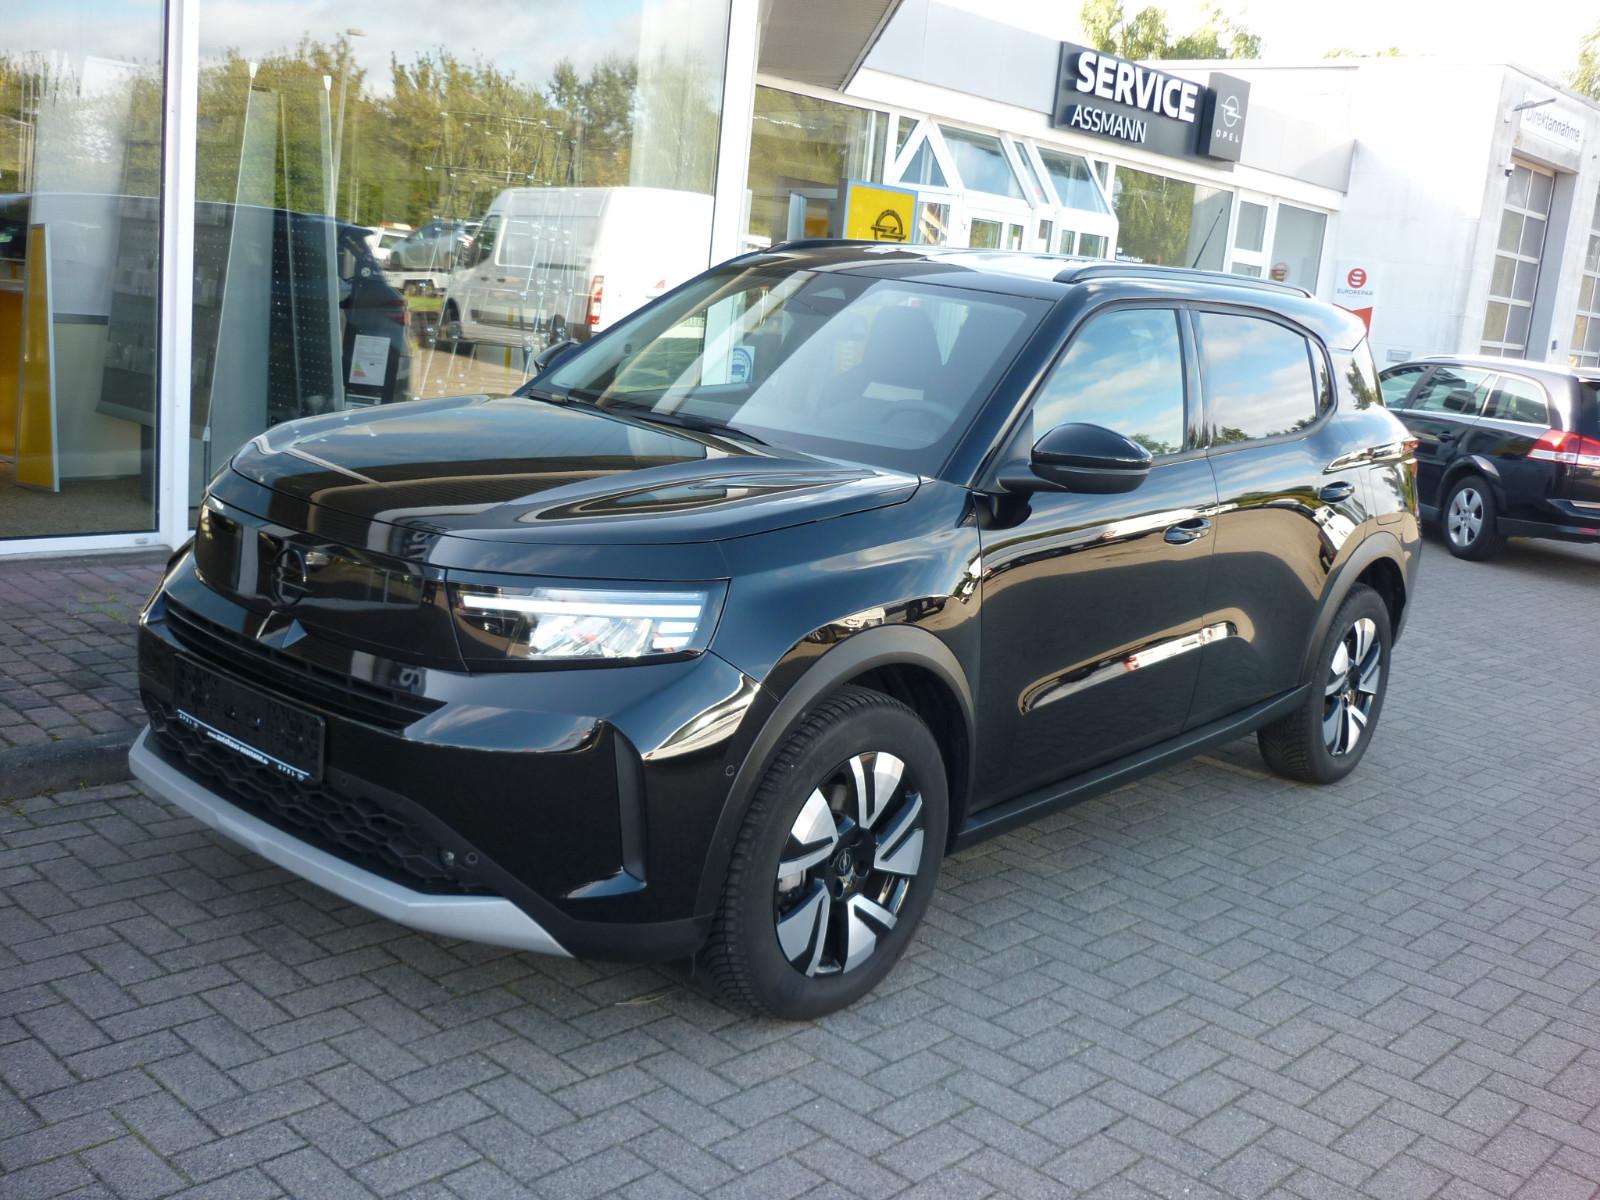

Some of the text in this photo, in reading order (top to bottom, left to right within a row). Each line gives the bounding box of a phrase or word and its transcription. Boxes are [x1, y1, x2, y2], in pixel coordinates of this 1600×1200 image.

[1075, 50, 1200, 123] SERVICE
[1070, 104, 1147, 144] ASSMANN
[1215, 129, 1240, 143] OPEL
